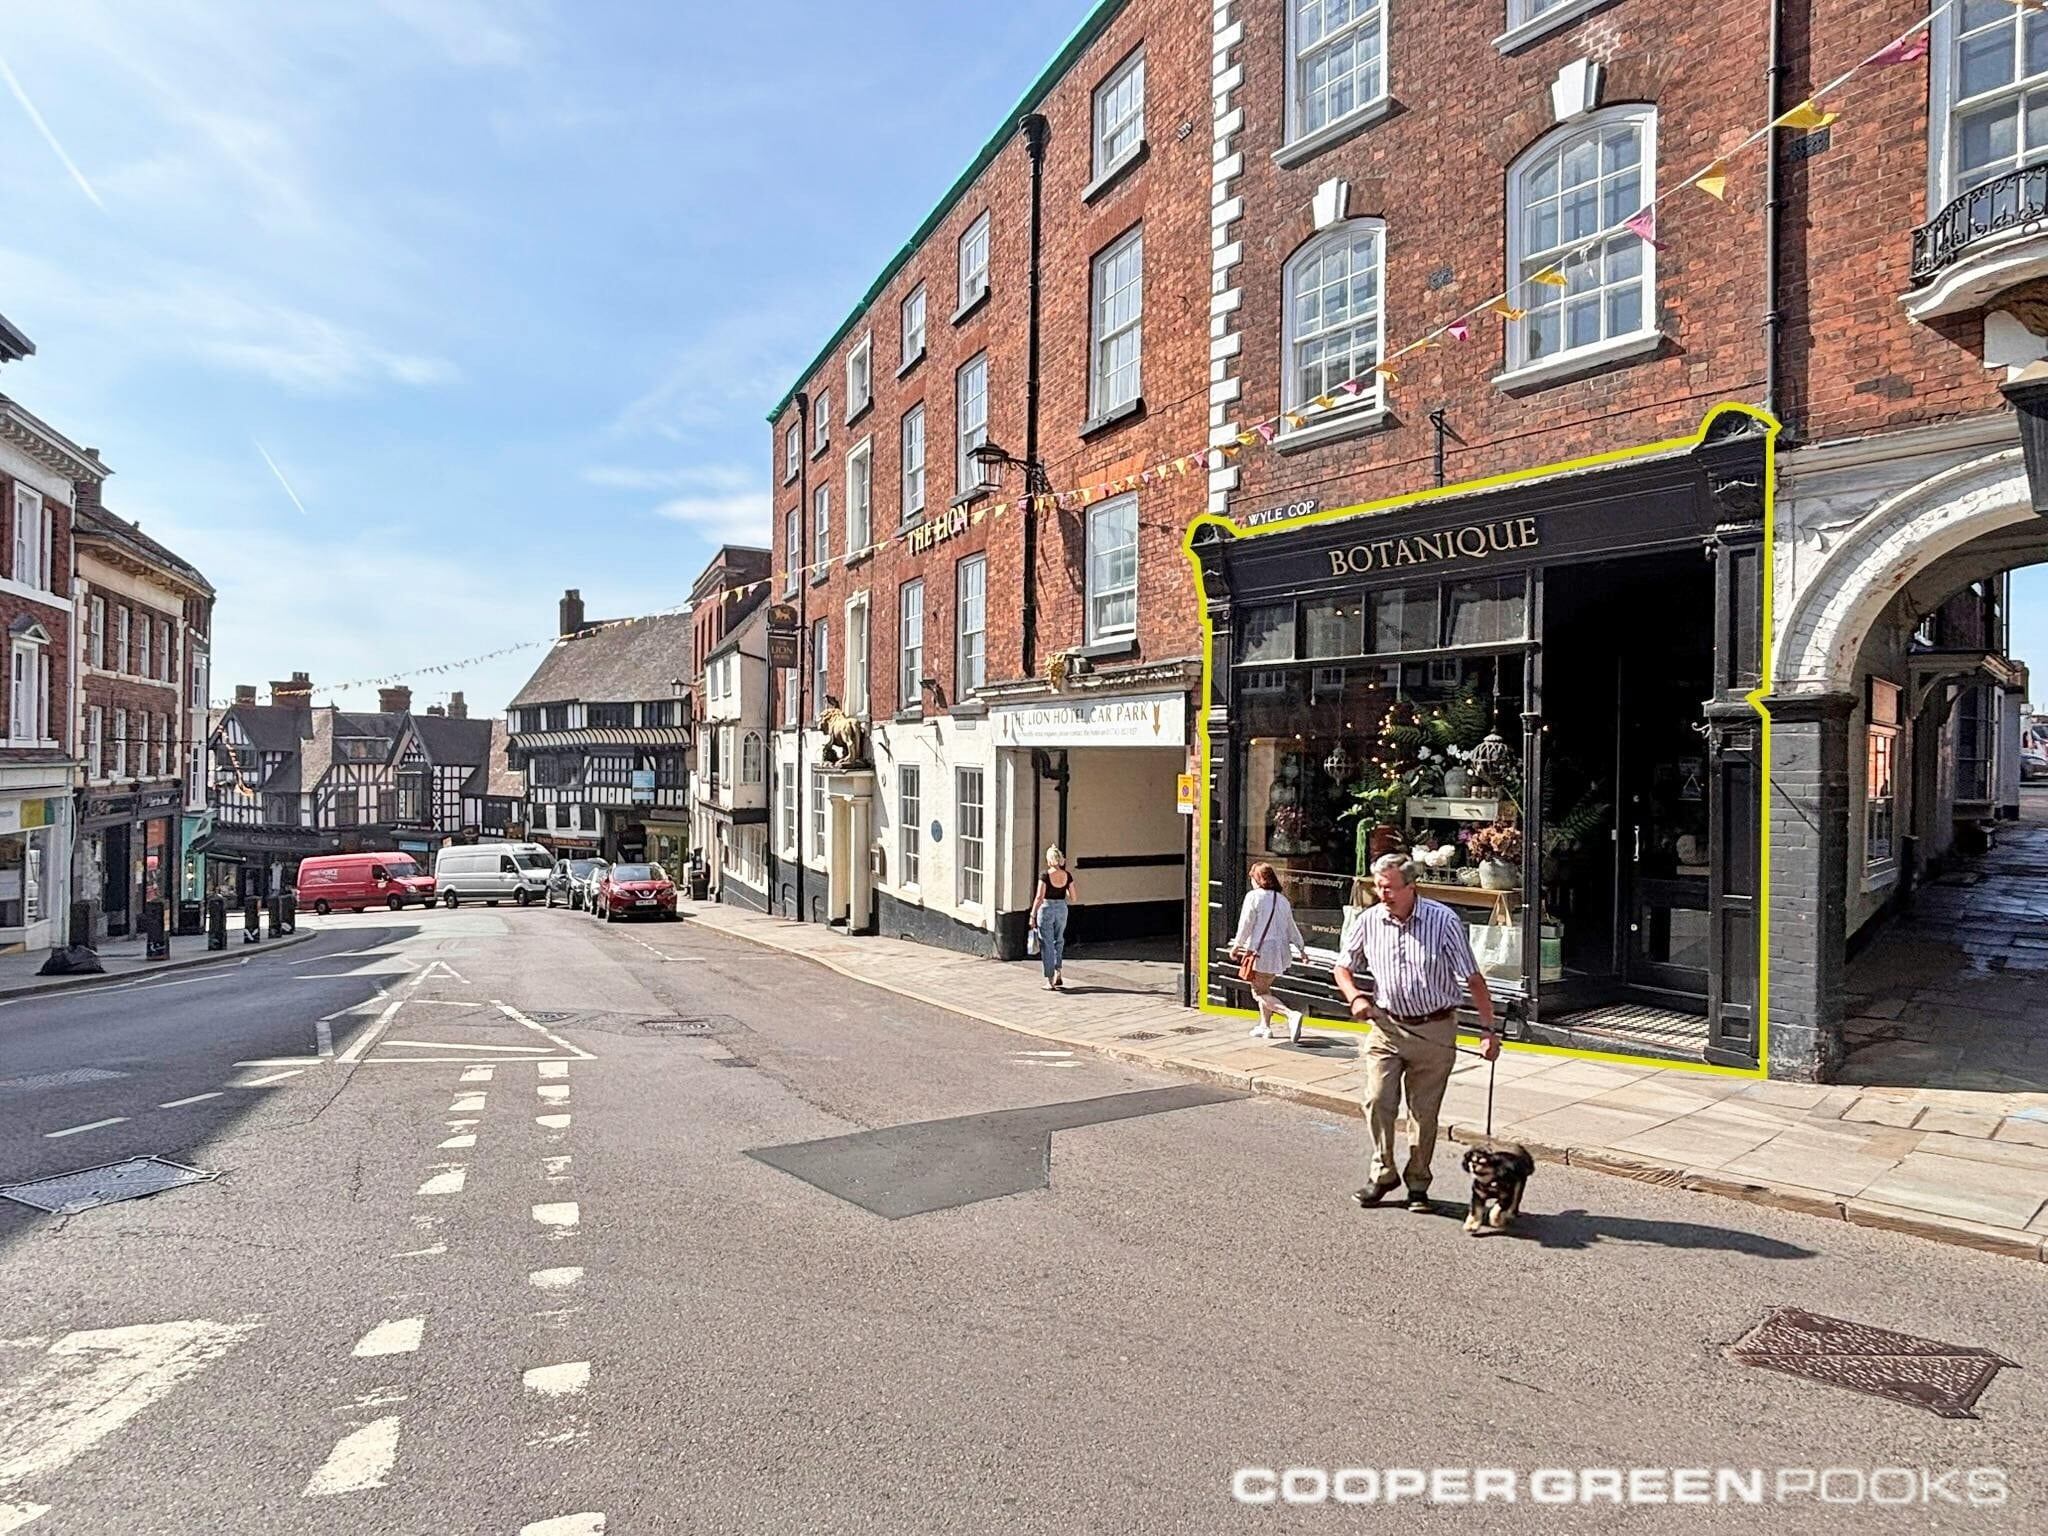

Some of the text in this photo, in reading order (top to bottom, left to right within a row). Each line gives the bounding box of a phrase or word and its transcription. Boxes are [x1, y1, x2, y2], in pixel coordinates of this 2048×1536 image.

[907, 501, 969, 555] THE LION
[1248, 500, 1315, 526] WYLE COP
[1328, 516, 1539, 576] BOTANIQUE
[1011, 702, 1148, 726] THE LION HOTEL CAR PARK
